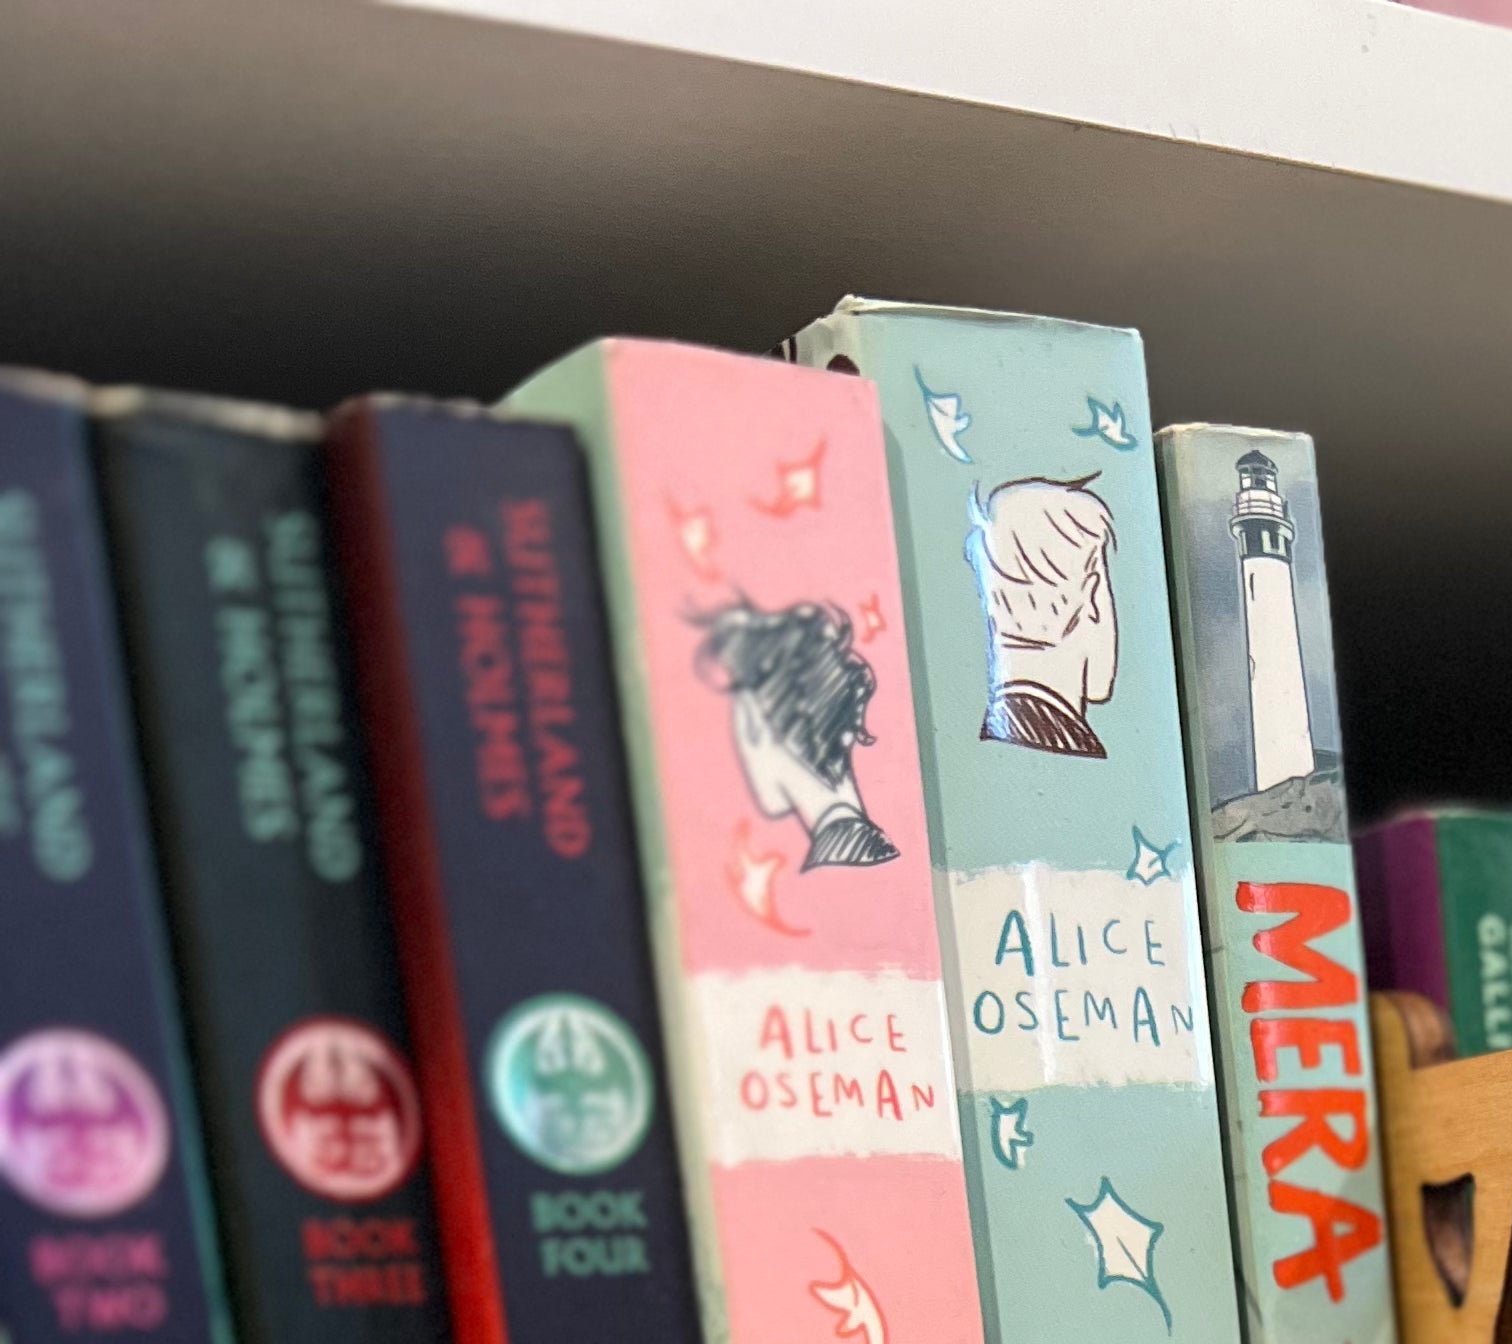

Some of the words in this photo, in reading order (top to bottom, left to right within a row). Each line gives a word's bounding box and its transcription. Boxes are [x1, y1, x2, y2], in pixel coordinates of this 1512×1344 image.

[500, 498, 590, 860] SUTHERLAND
[995, 909, 1166, 976] ALICE
[759, 1003, 908, 1060] ALICE
[972, 985, 1194, 1047] OSEMAN
[739, 1068, 936, 1121] OSEMAN
[1235, 880, 1387, 1303] MERA
[300, 1217, 421, 1261] BOOK
[530, 1192, 648, 1235] BOOK
[29, 1233, 169, 1287] BOOK
[541, 1234, 650, 1277] FOUR
[54, 1283, 168, 1333] TWO
[308, 1260, 427, 1307] THREE
